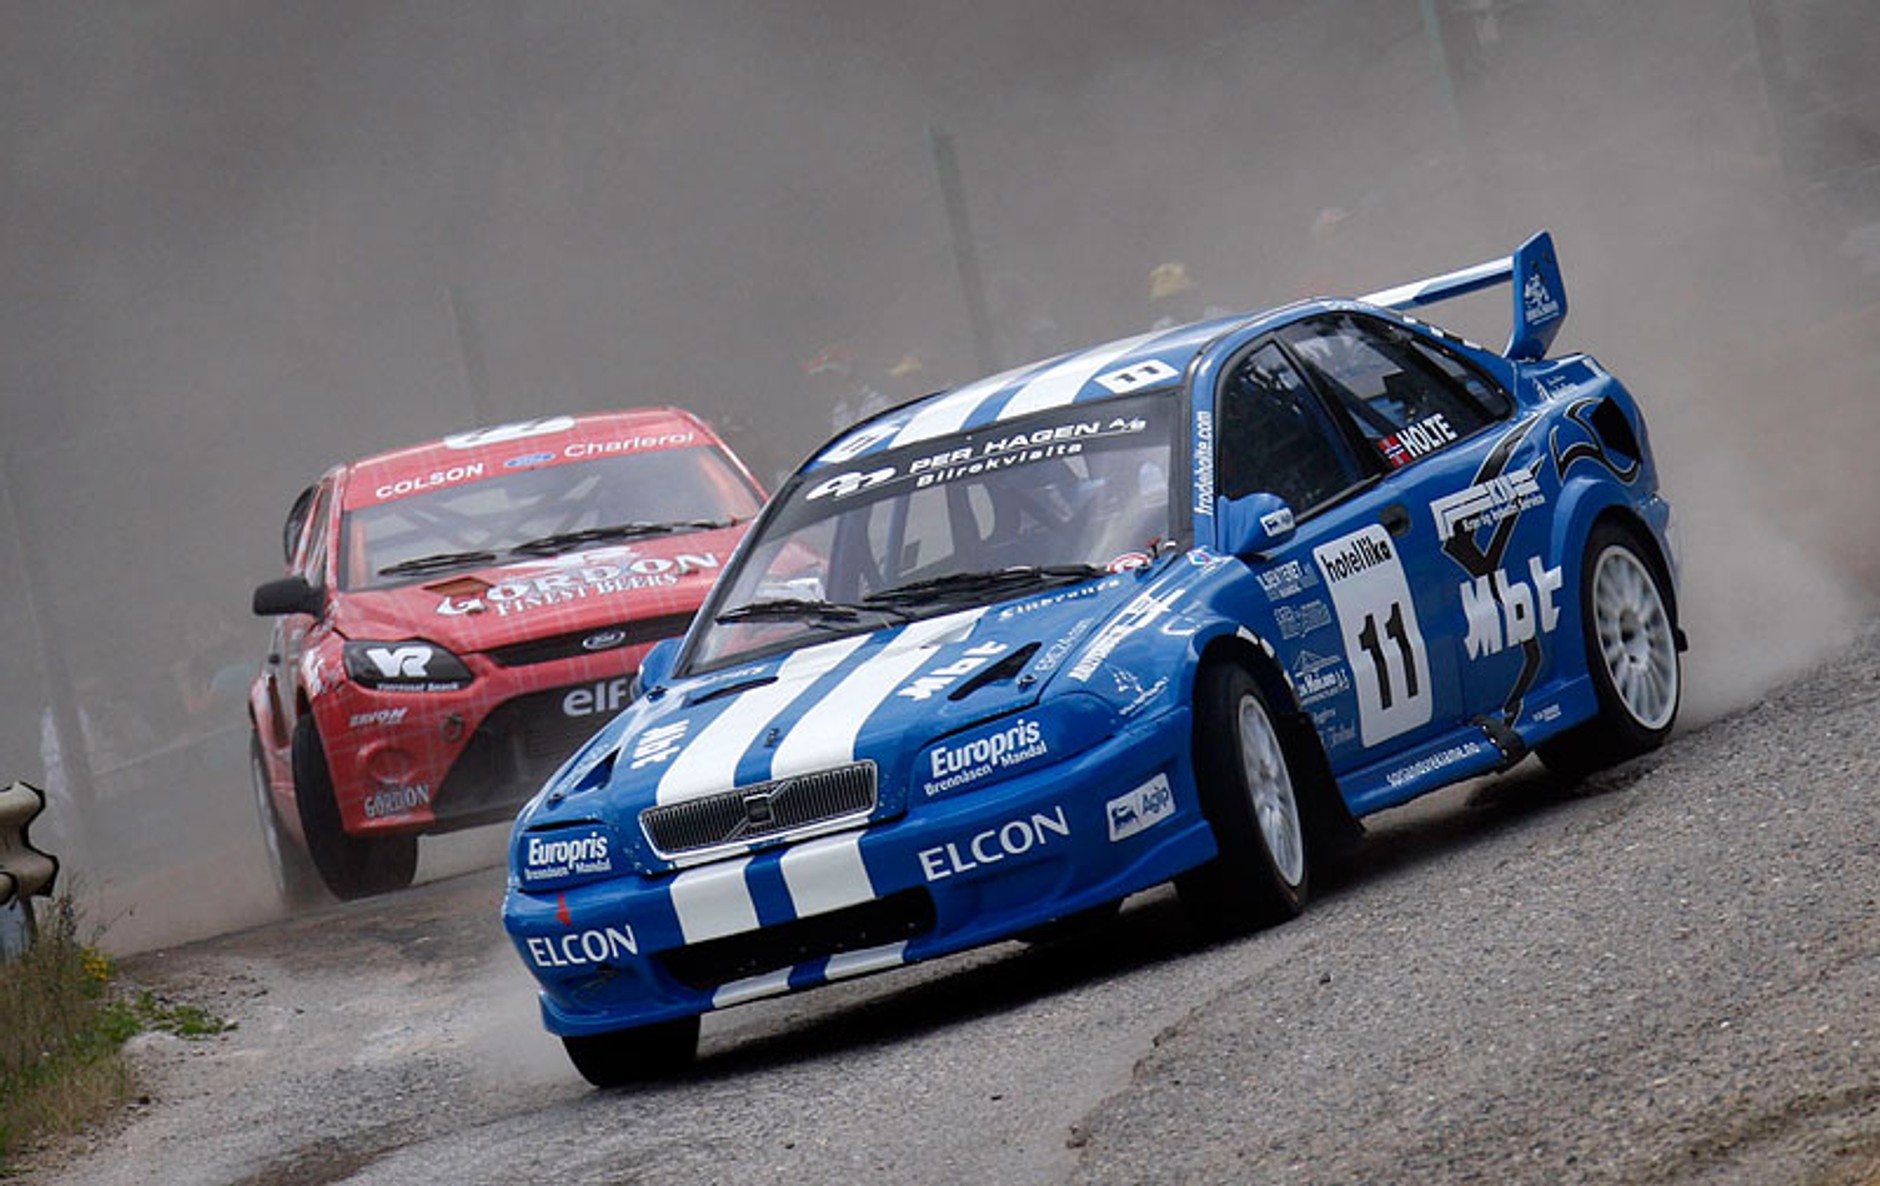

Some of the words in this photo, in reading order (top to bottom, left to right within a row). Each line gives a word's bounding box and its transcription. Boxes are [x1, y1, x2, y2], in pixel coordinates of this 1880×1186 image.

[563, 431, 695, 458] Charleroi
[908, 446, 974, 474] PER
[984, 421, 1100, 456] HAGEN
[1395, 412, 1459, 458] HOLTE
[375, 463, 485, 499] COLSON
[915, 442, 1083, 488] Bilrekvisita
[436, 552, 720, 616] GORDON
[496, 583, 588, 616] FINEST
[594, 571, 678, 596] BEERS
[366, 646, 434, 678] VR
[1357, 601, 1421, 711] 11
[562, 678, 628, 718] elf
[929, 718, 1041, 780] Europris
[1000, 739, 1049, 769] Mandal
[527, 831, 609, 870] Europris
[917, 804, 1071, 883] ELCON
[526, 923, 639, 967] ELCON
